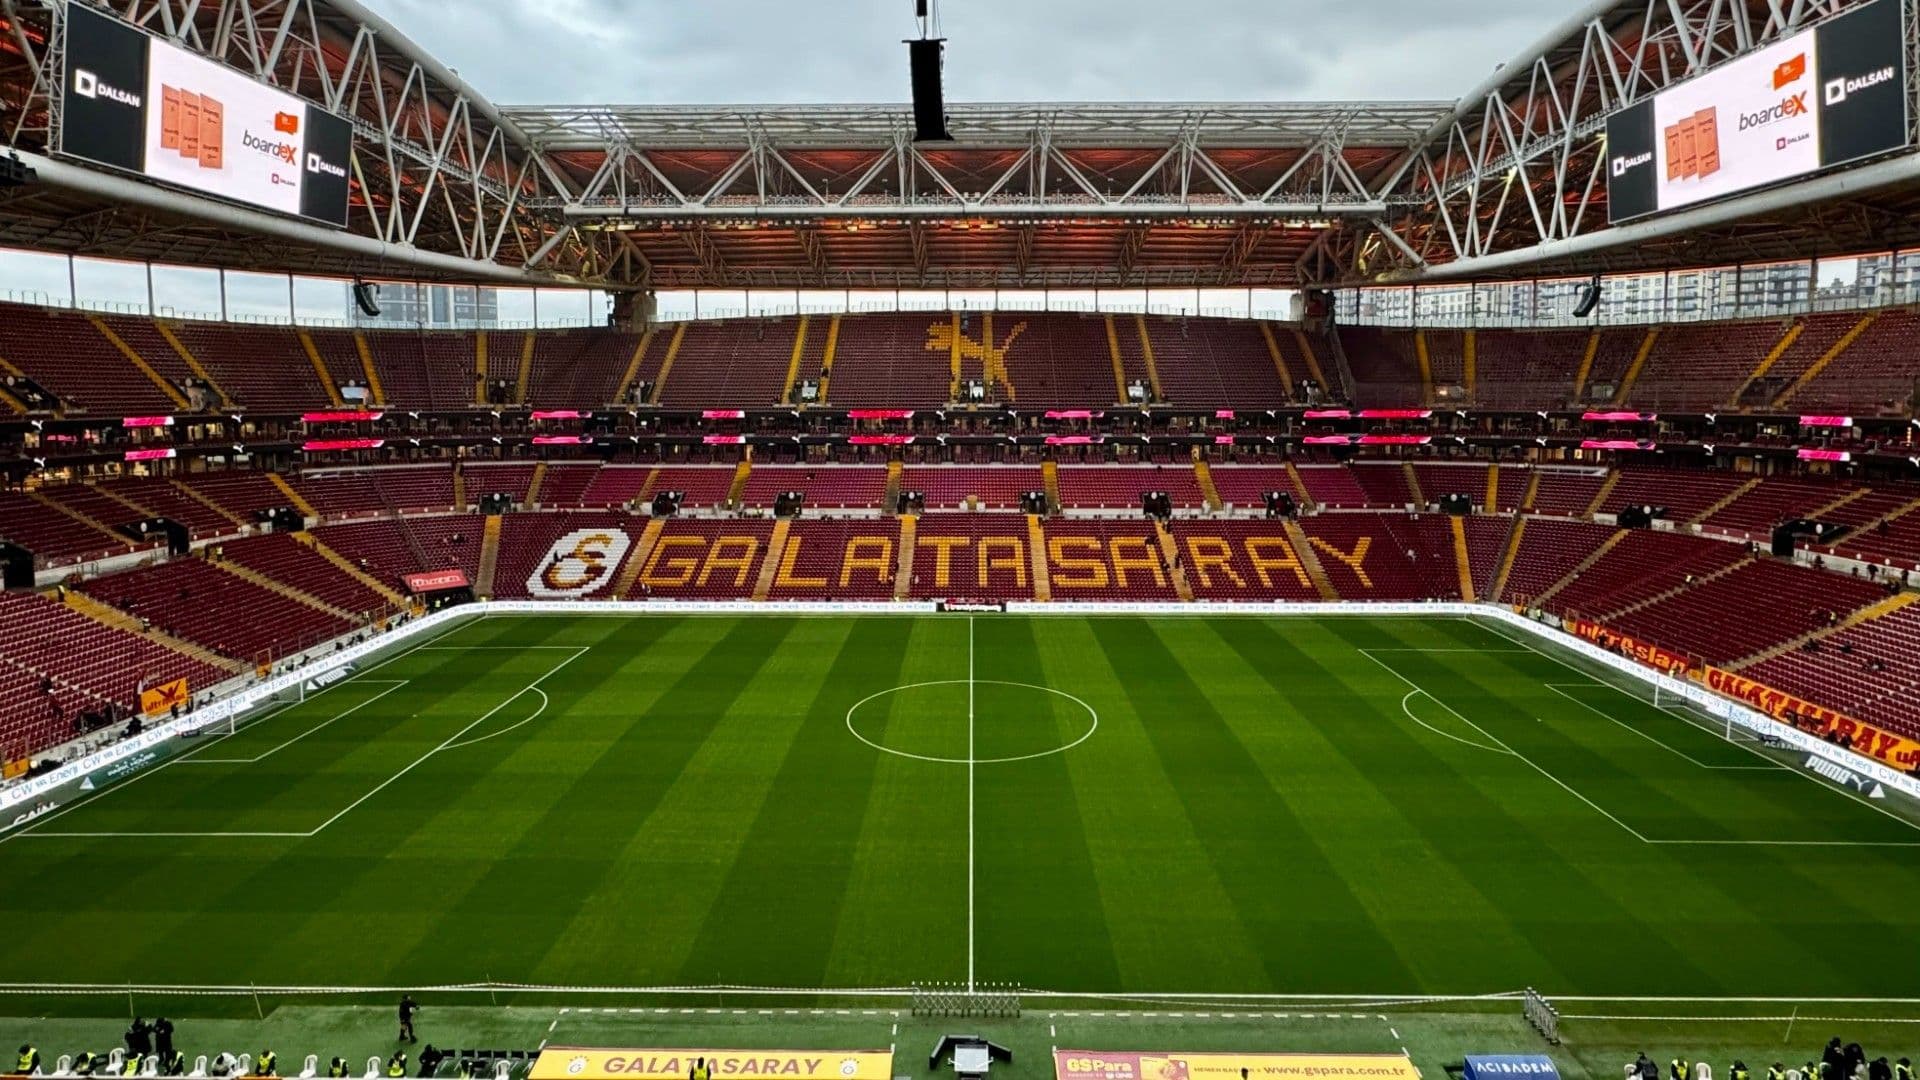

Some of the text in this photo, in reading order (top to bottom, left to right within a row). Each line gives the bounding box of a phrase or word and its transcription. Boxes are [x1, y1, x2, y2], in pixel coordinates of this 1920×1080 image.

[1847, 66, 1894, 93] DALSAN
[97, 83, 141, 108] DALSAN
[1625, 152, 1652, 168] DALSAN
[11, 780, 34, 800] CW
[82, 753, 102, 771] CW
[1805, 755, 1852, 785] PUMA
[1879, 767, 1900, 785] CW
[1066, 1058, 1133, 1072] GSPara
[1263, 1066, 1405, 1077] www.gspara.com.tr
[1476, 1062, 1554, 1073] ACIBADEM
